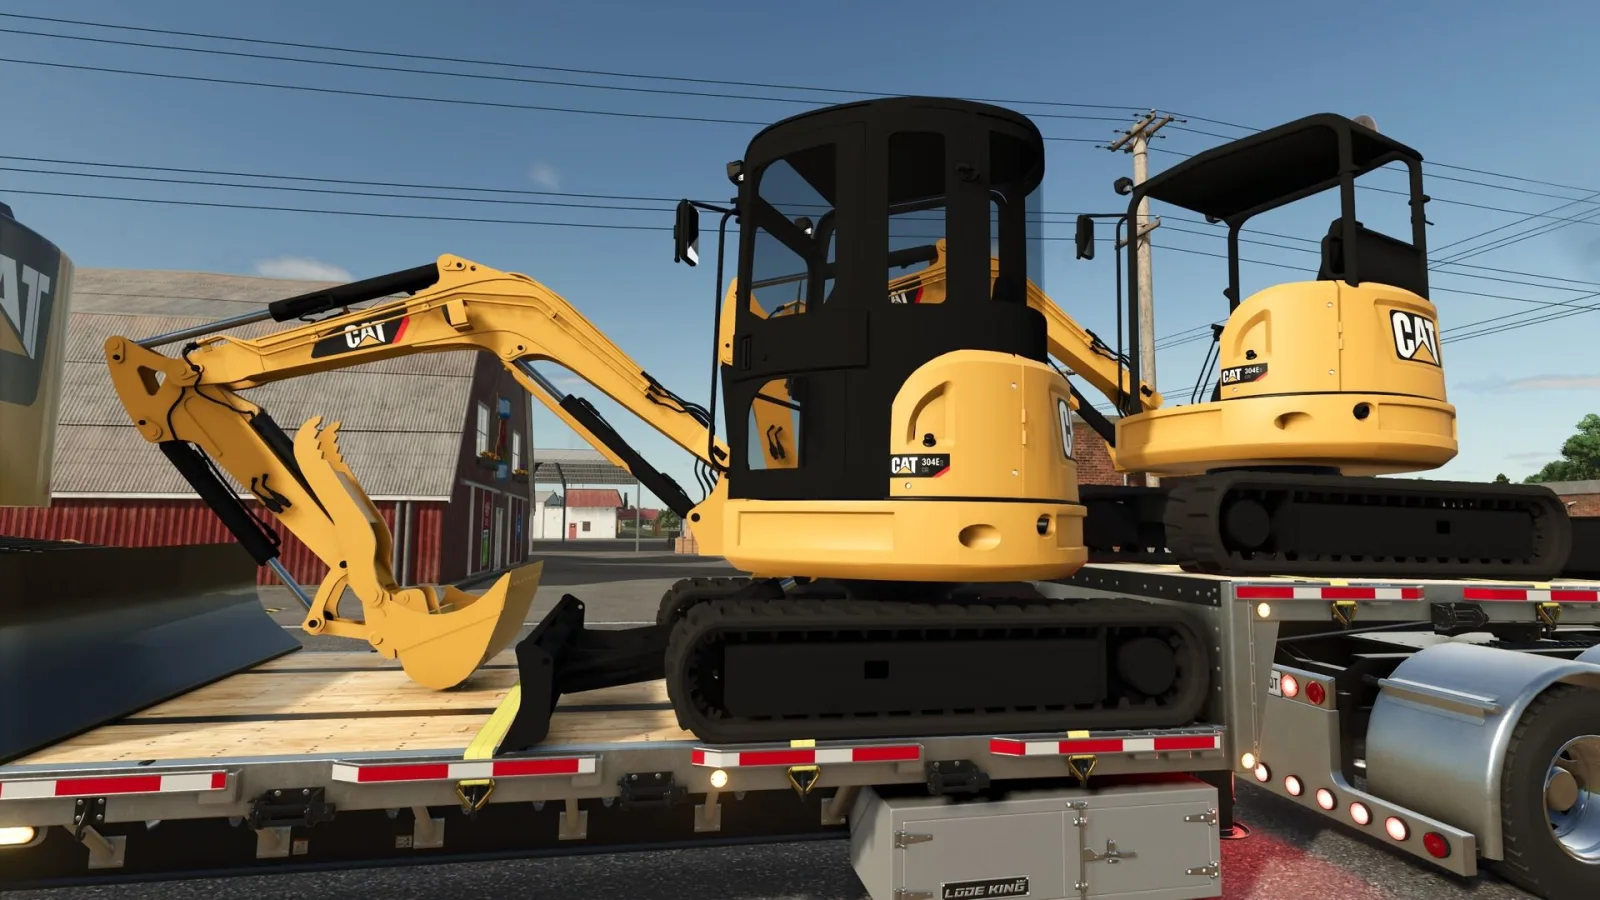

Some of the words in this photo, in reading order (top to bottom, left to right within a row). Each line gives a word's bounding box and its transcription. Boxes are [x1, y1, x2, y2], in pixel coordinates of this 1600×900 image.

[0, 253, 50, 360] AT
[344, 320, 386, 348] CAT
[1392, 312, 1440, 366] CAT
[1222, 368, 1242, 383] CAT
[891, 456, 918, 474] CAT
[944, 886, 985, 899] LODE
[988, 882, 1026, 895] KING
